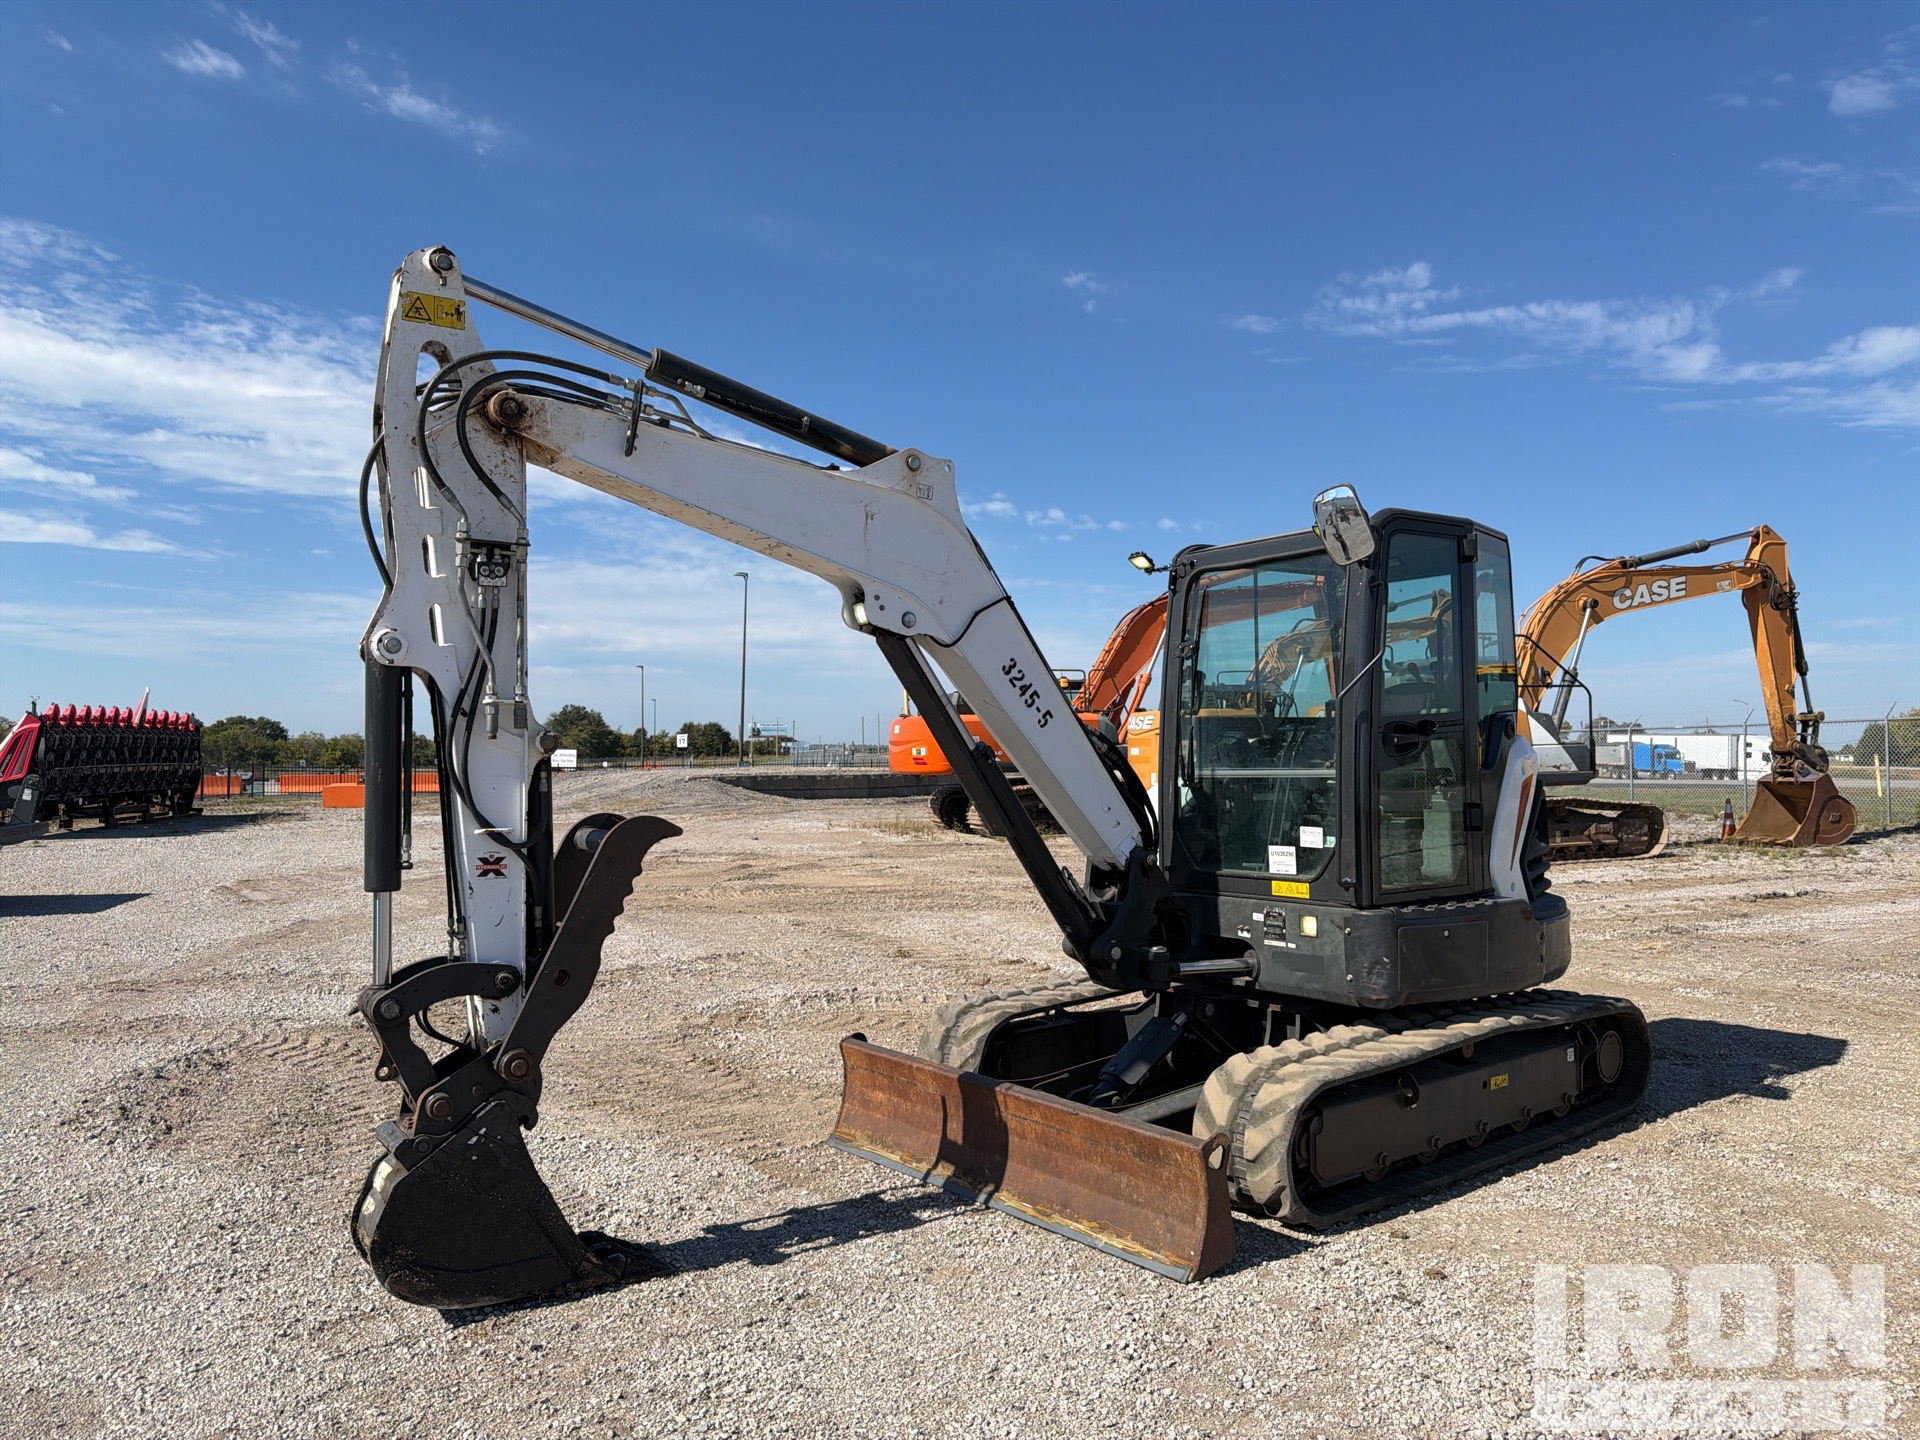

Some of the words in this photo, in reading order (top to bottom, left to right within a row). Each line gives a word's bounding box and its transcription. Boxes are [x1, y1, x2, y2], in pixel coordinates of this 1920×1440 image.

[1612, 575, 1687, 610] CASE
[1002, 657, 1054, 728] 3245-5
[1127, 715, 1155, 730] ASE
